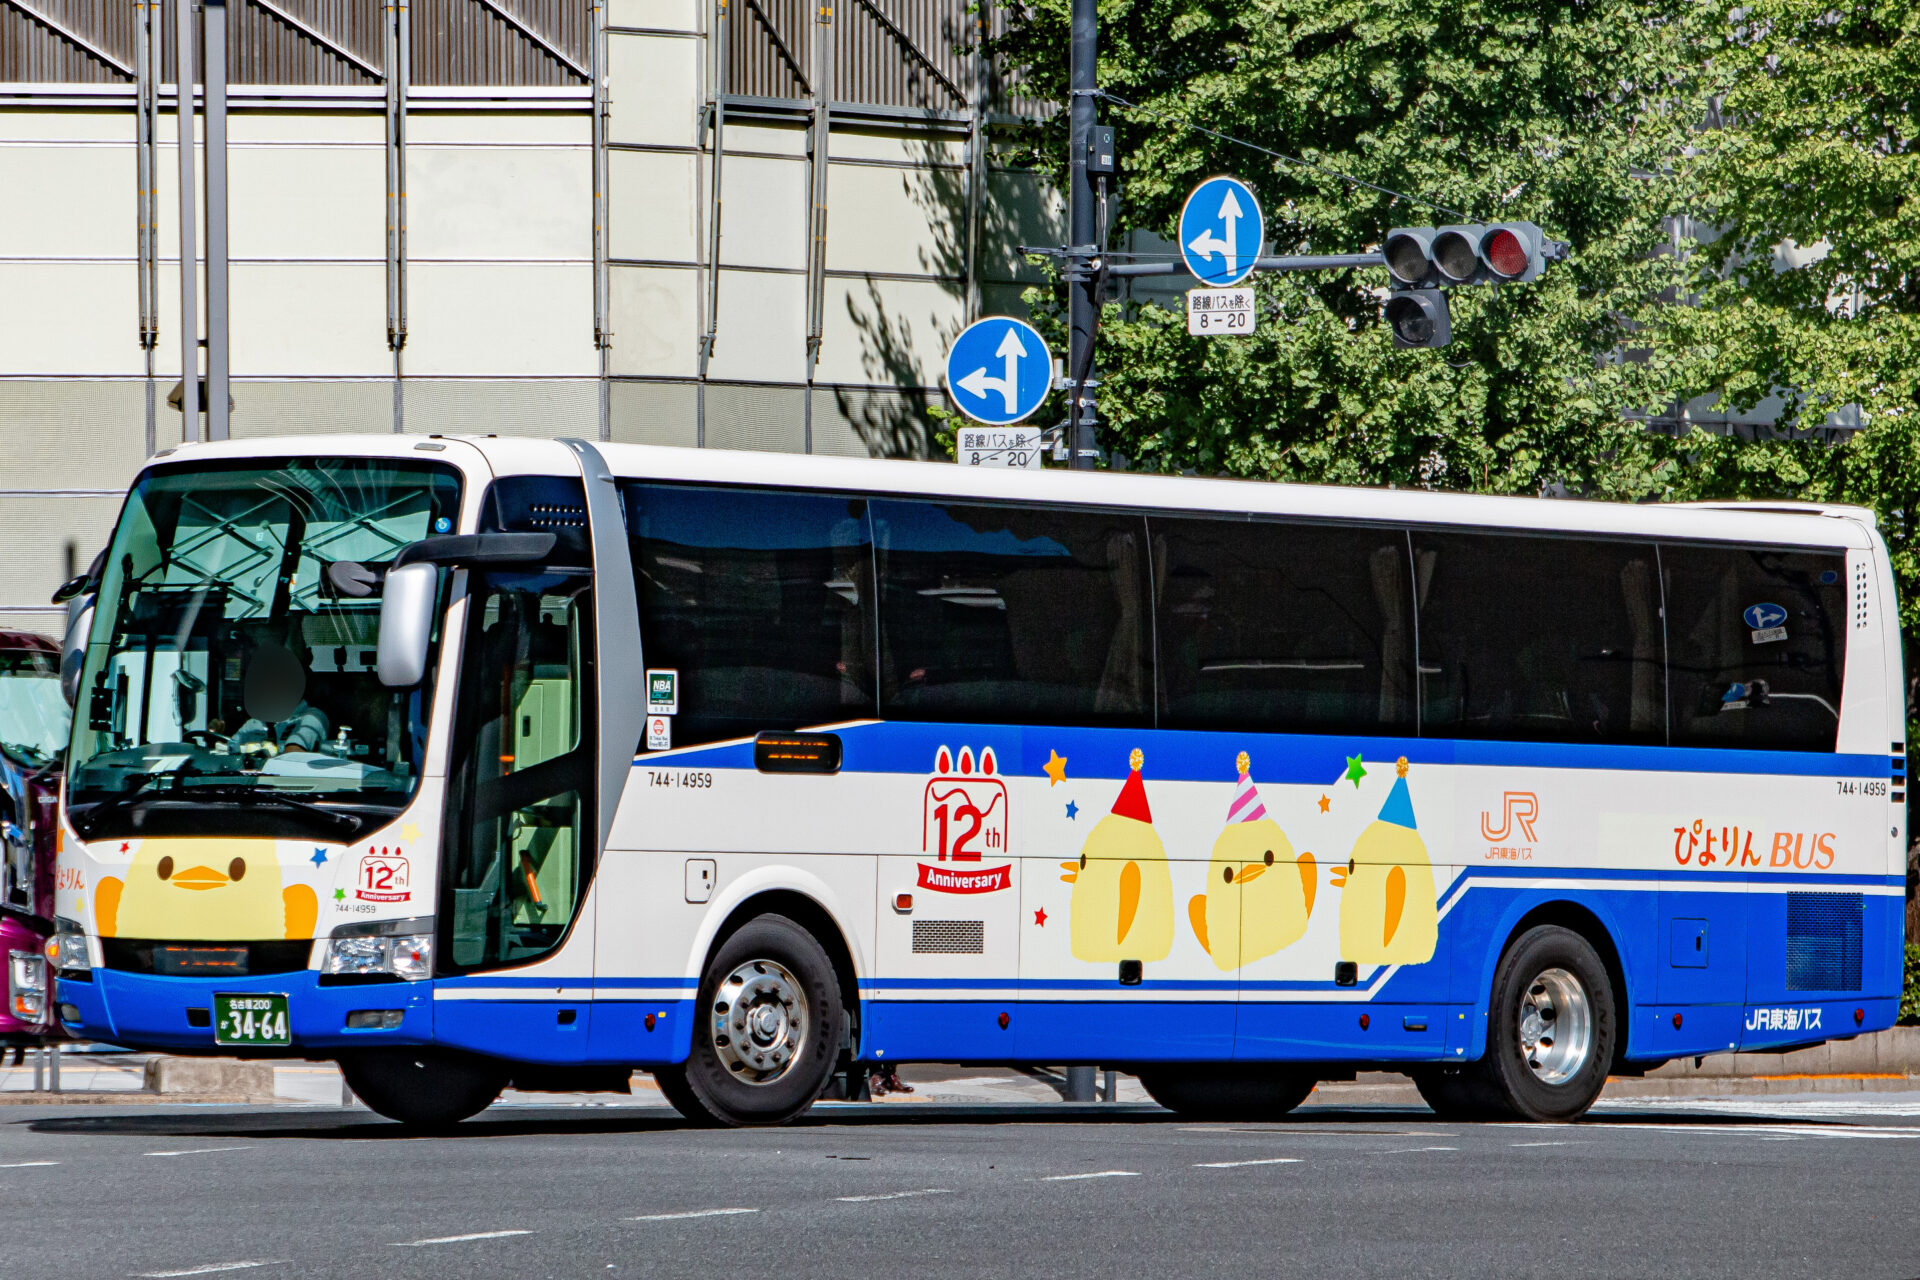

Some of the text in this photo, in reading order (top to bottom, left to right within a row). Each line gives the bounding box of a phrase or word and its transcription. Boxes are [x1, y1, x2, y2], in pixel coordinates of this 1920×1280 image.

[1193, 295, 1250, 310] 路線バスを除く
[964, 433, 1033, 448] 路線バスを除く
[653, 680, 671, 691] NBA
[648, 771, 712, 788] 744-14959
[1837, 781, 1886, 796] 744-14959
[1481, 791, 1539, 843] JR
[1674, 818, 1837, 870] ぴよりん BUS
[1484, 846, 1533, 861] JR東海バス
[926, 868, 1003, 889] Anniversary
[360, 891, 406, 902] Anniversary
[336, 904, 377, 914] 744-14959
[229, 1011, 287, 1040] 34-64
[1745, 1008, 1822, 1031] JR東海バス
